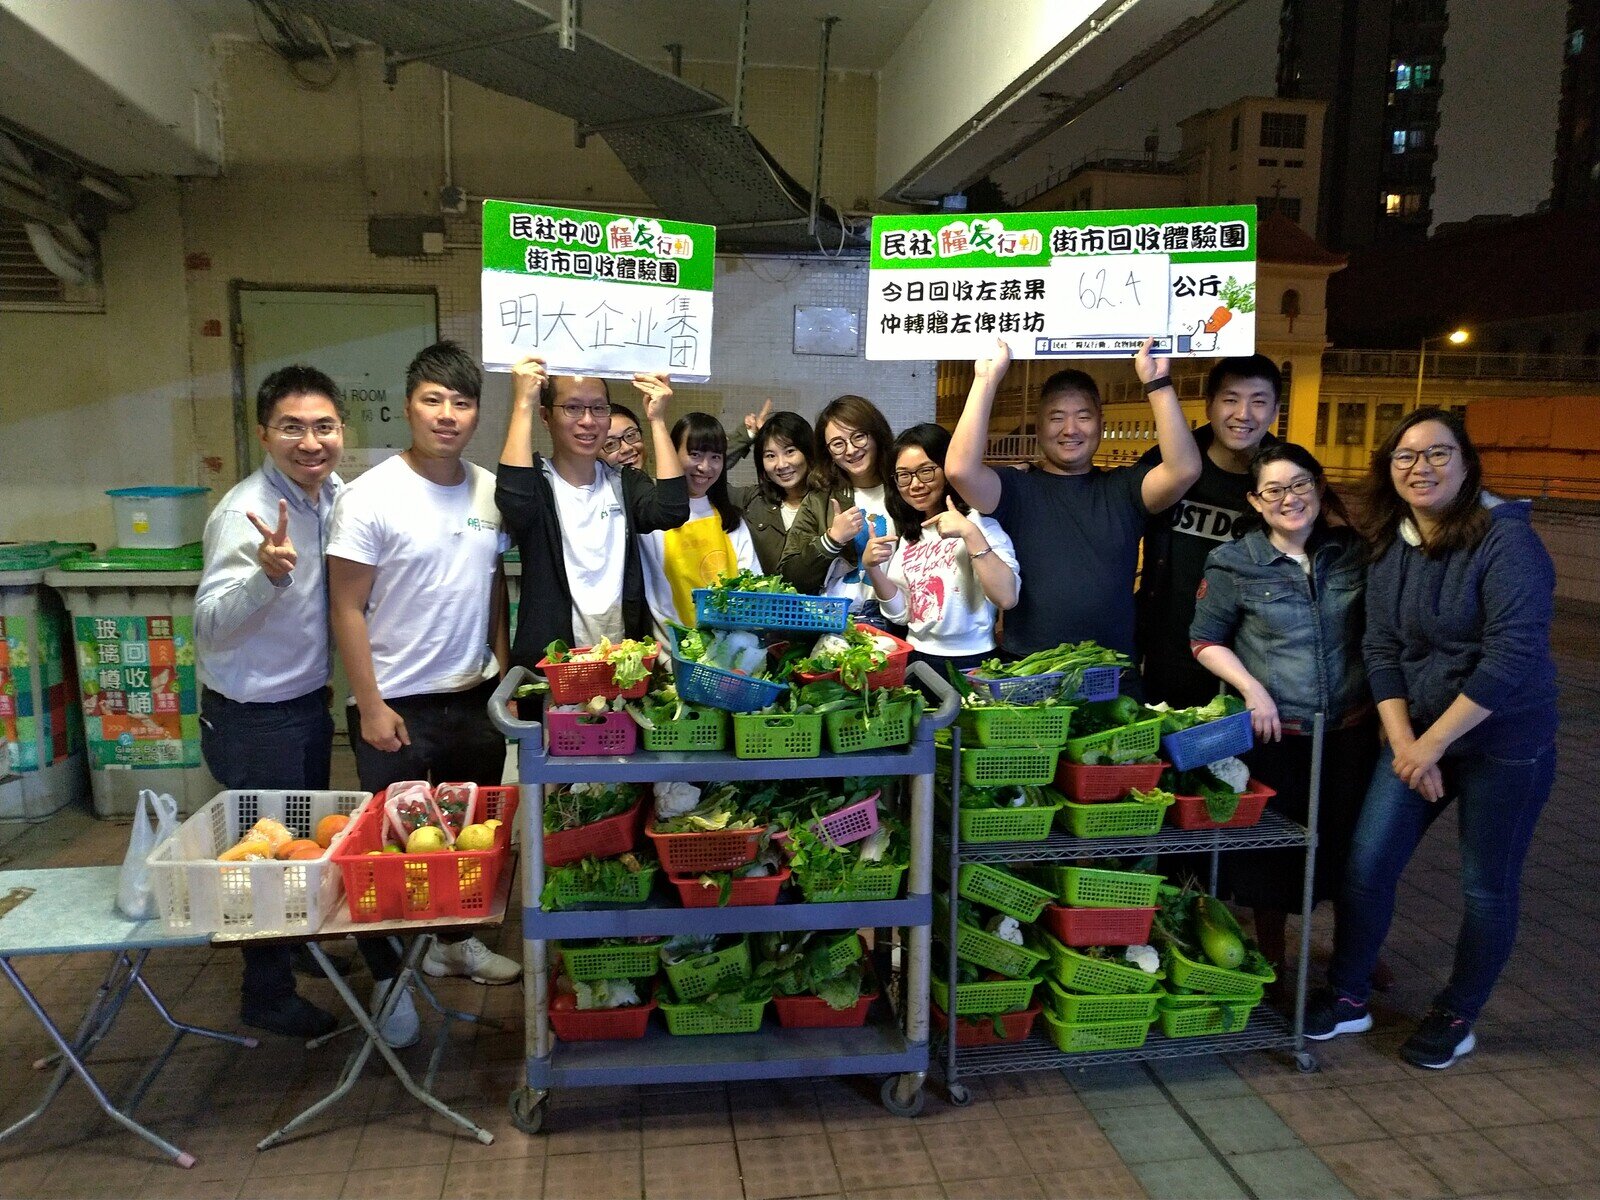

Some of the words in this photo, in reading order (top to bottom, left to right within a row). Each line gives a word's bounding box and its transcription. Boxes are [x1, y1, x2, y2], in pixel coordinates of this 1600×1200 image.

[512, 215, 600, 246] 民社中心
[884, 231, 932, 257] 民社
[1052, 223, 1246, 254] 街市回收體驗團
[527, 250, 679, 284] 街市回收體驗團
[881, 278, 1046, 302] 今日回收左蔬果
[1078, 267, 1141, 310] 62.4
[1172, 274, 1222, 298] 公斤
[880, 311, 1046, 335] 仲轉贈左俾街坊
[352, 389, 386, 402] ROOM
[381, 406, 391, 422] C
[1169, 501, 1212, 533] UST
[95, 618, 122, 689] 玻璃樽
[124, 643, 153, 713] 回收桶
